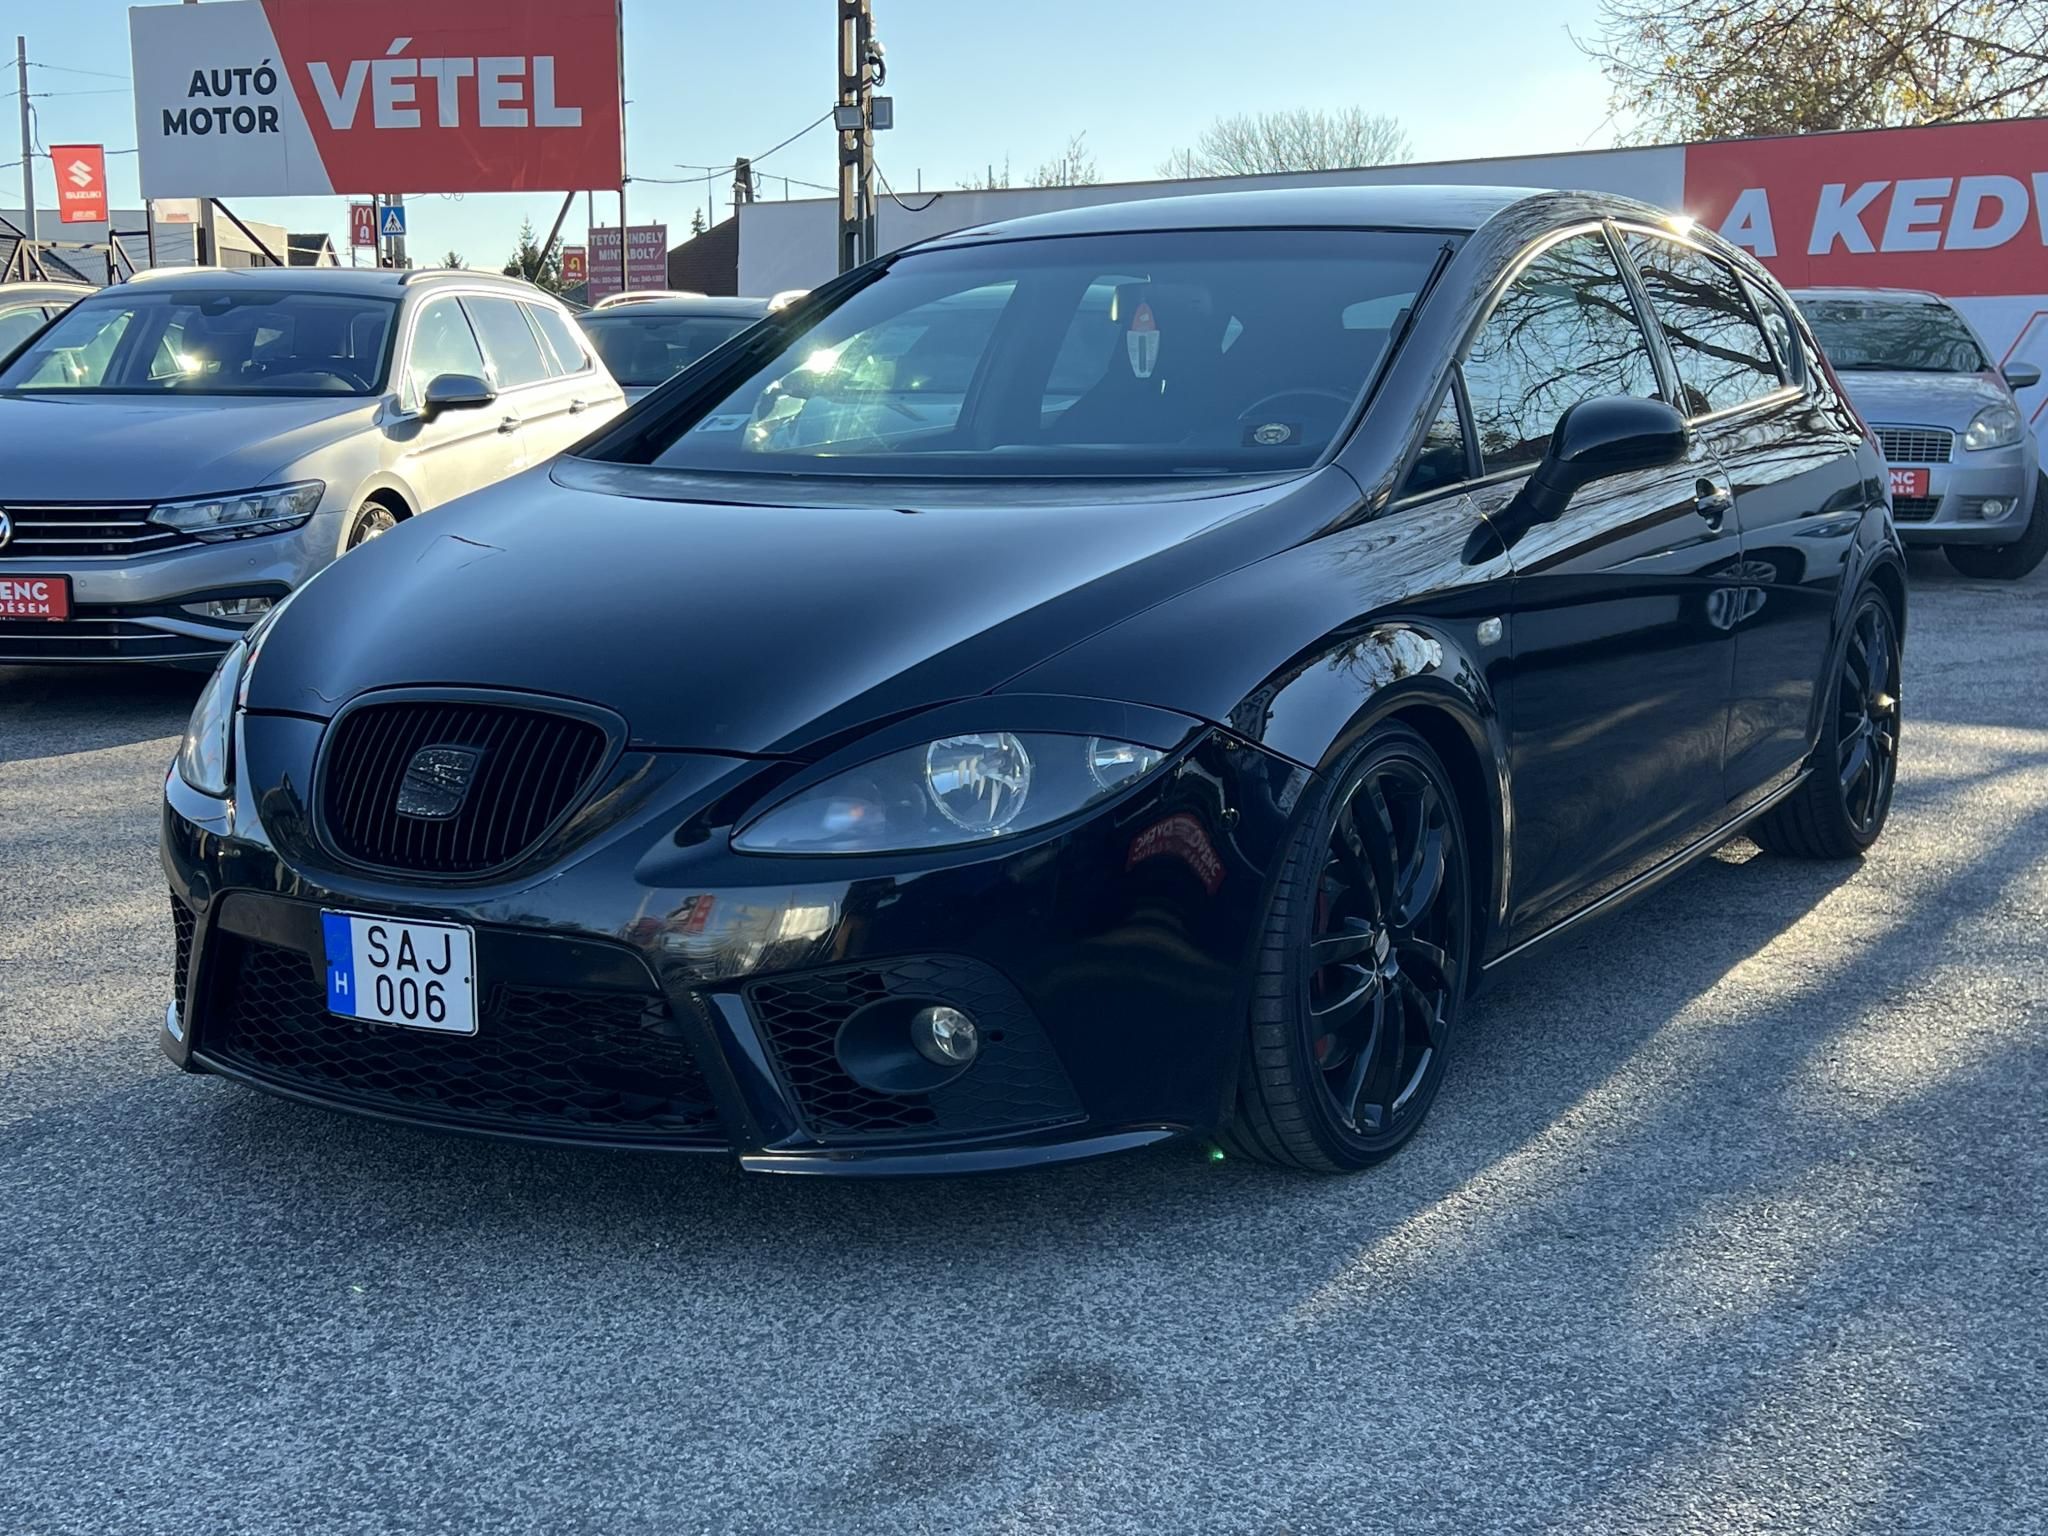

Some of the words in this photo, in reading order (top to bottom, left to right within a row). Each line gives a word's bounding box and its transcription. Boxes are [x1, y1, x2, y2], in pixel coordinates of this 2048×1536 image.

[188, 59, 278, 97] AUTÓ
[307, 37, 582, 130] VÉTEL
[163, 105, 279, 136] MOTOR
[65, 191, 101, 200] SUZUKI
[590, 230, 664, 246] TETŐZINDELY
[1716, 188, 1778, 257] A
[367, 926, 452, 976] SAJ
[335, 970, 348, 995] H
[375, 974, 447, 1023] 006
